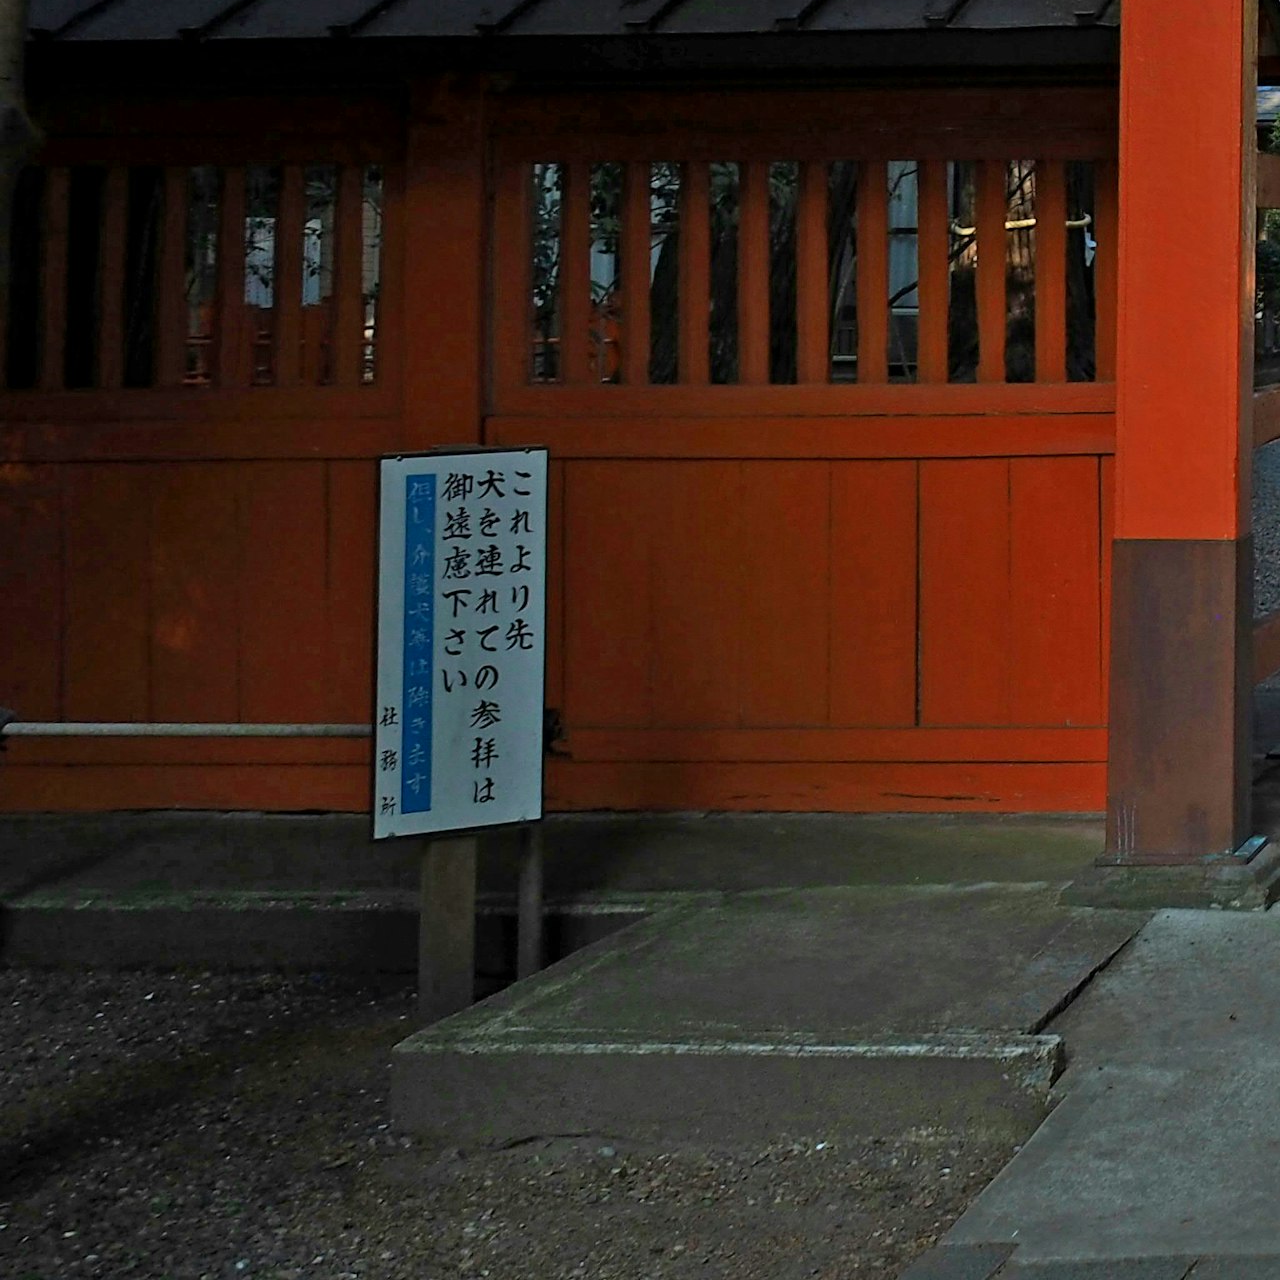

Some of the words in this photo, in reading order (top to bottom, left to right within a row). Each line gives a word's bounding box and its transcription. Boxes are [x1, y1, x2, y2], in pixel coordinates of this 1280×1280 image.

[441, 473, 474, 693] 御遠慮下さい
[470, 470, 505, 803] 犬を連れての参拝は
[505, 470, 534, 651] これより先
[380, 706, 399, 816] 社務所
